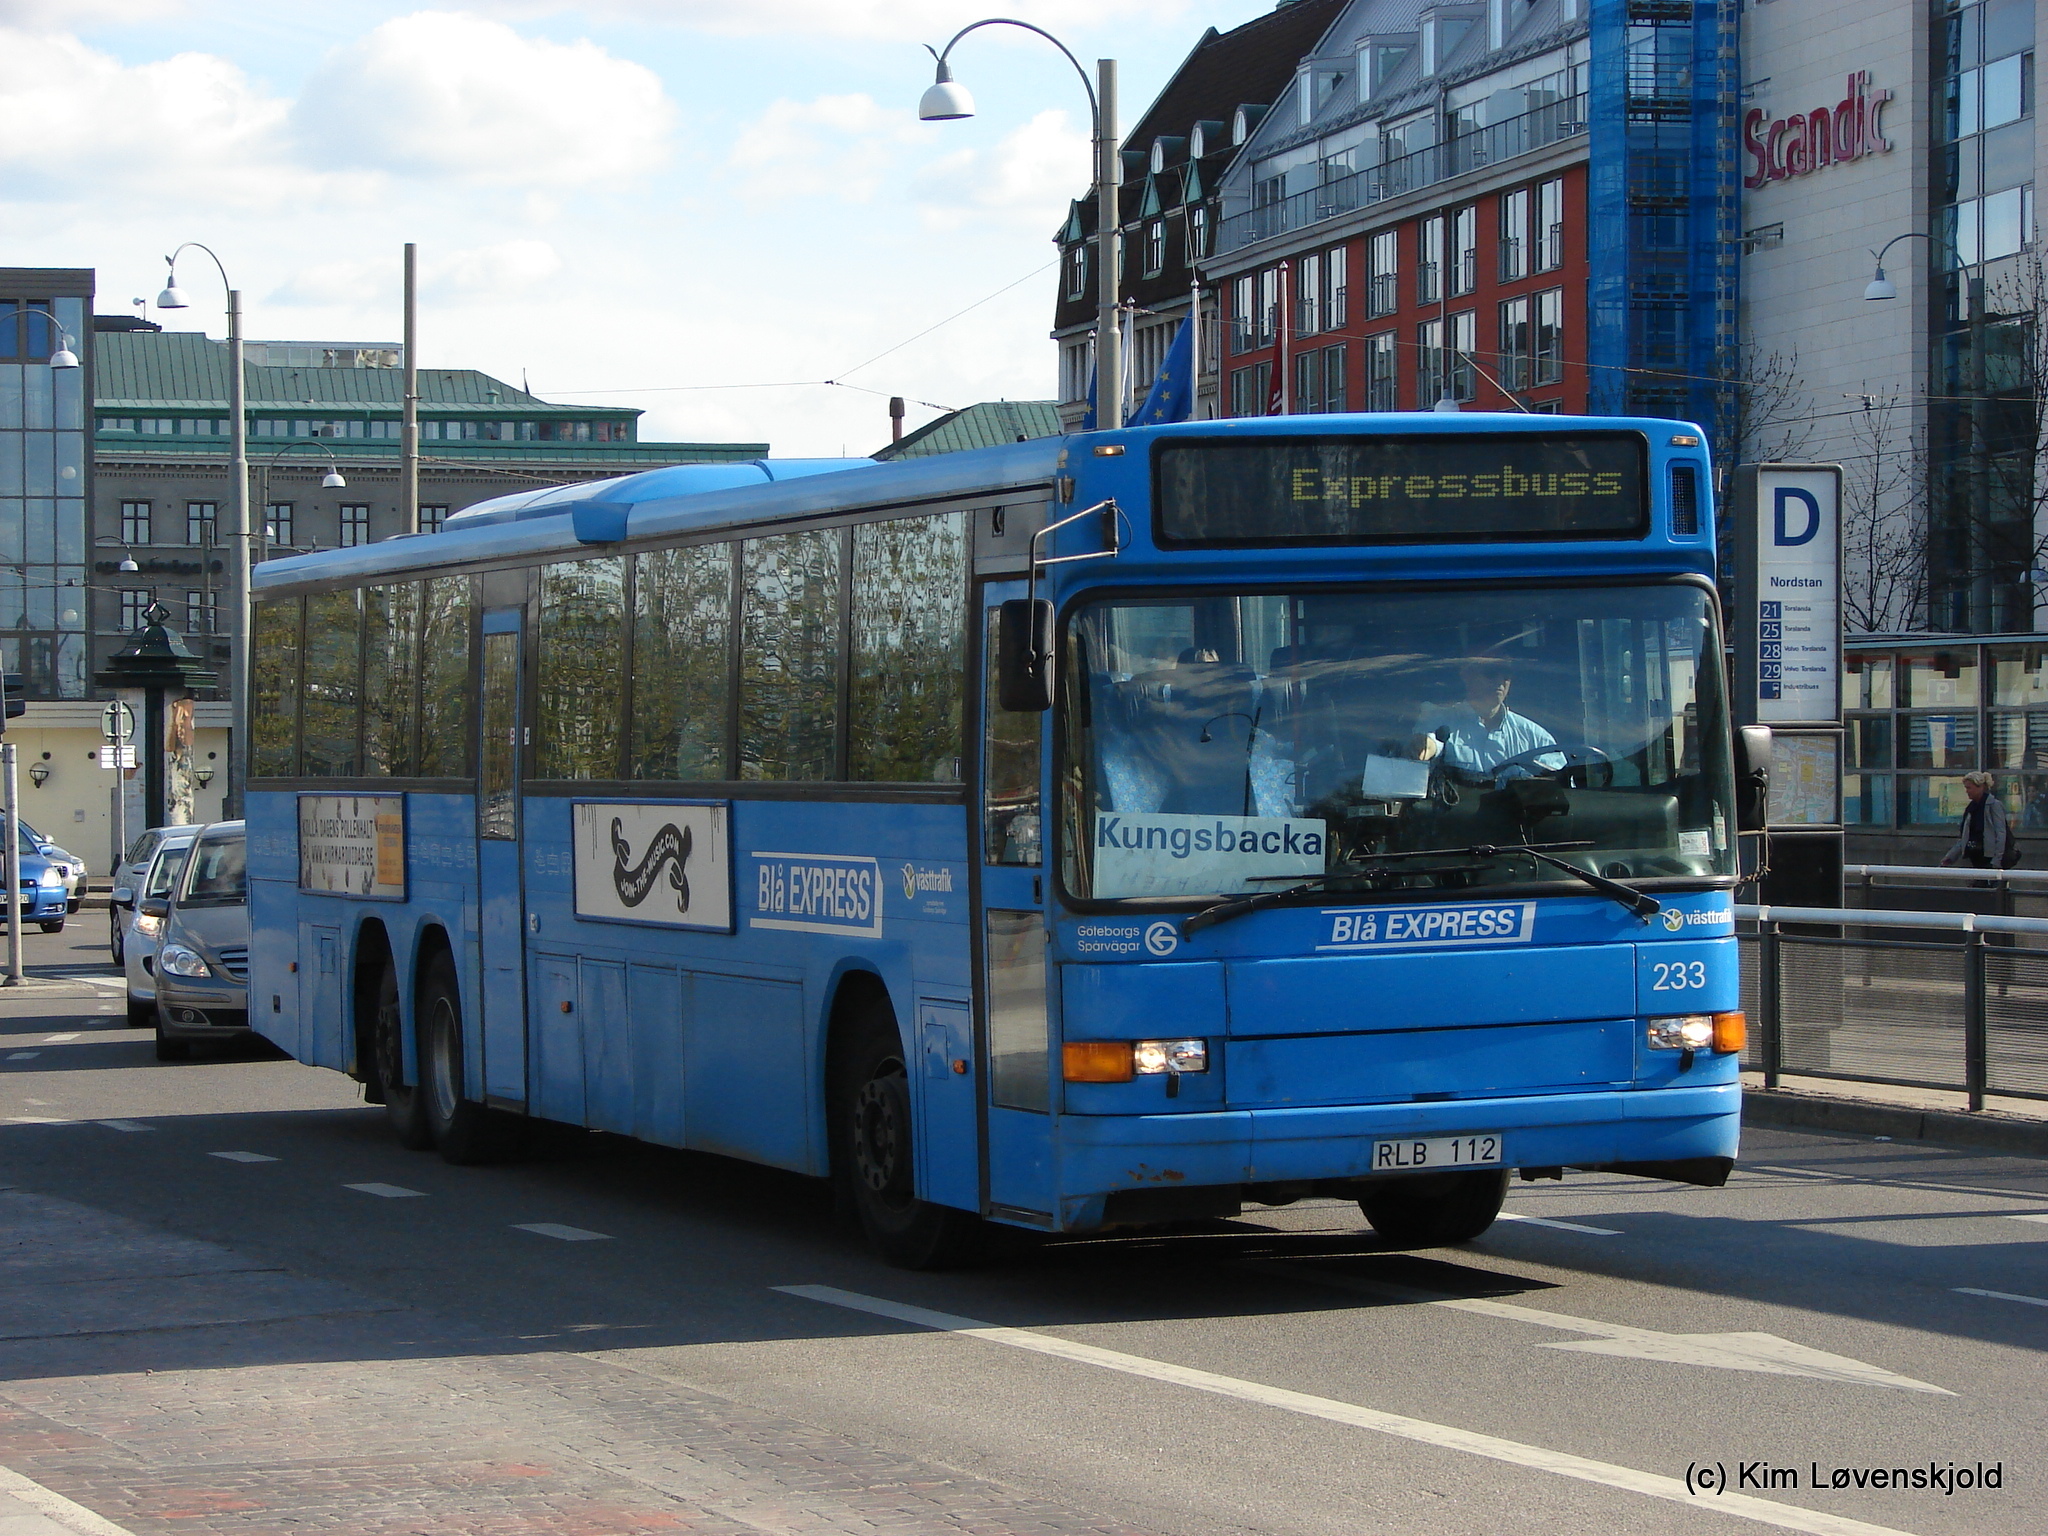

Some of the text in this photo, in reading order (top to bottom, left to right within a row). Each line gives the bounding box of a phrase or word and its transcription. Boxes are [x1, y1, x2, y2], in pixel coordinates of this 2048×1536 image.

[1744, 70, 1892, 189] Scandic
[1292, 465, 1623, 509] Expressbuss
[1774, 487, 1820, 546] D
[1770, 576, 1823, 588] Nordstan
[1762, 603, 1778, 618] 21
[1762, 623, 1780, 638] 25
[1763, 644, 1781, 659] 28
[1764, 664, 1781, 679] 29
[1098, 816, 1322, 859] Kungsbacka
[758, 863, 871, 920] Blå EXPRESS
[915, 867, 952, 892] västtrafik
[1077, 925, 1140, 938] Göteborgs
[1331, 908, 1516, 942] Blå EXPRESS
[1077, 939, 1140, 954] Spårvägar
[1653, 961, 1706, 990] 233
[1378, 1137, 1496, 1167] RLB 112
